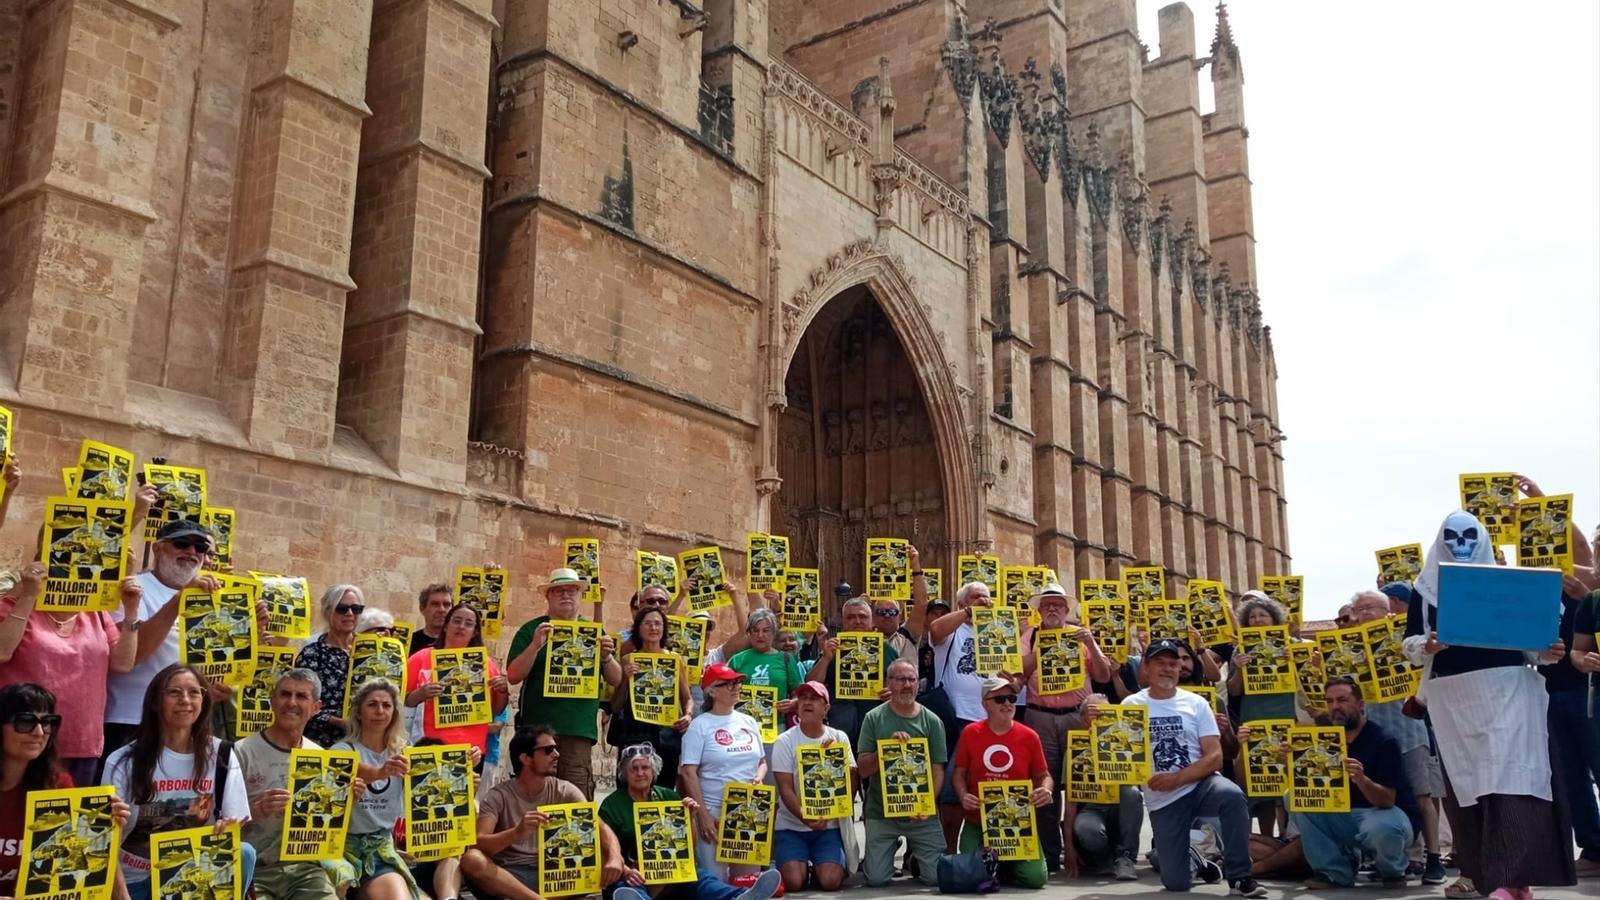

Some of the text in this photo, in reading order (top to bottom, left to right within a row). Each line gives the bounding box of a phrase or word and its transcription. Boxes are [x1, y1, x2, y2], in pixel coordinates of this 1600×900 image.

[1522, 557, 1553, 566] MALLORCA
[46, 581, 97, 593] MALLORCA
[44, 595, 56, 606] AL
[549, 677, 580, 685] MALLORCA
[1379, 674, 1413, 687] MALLORCA
[548, 685, 555, 693] AL
[439, 705, 472, 714] MALLORCA
[241, 712, 273, 722] MALLORCA
[440, 716, 447, 724] AL
[240, 723, 248, 732] AL
[1099, 763, 1131, 771] MALLORCA
[1251, 775, 1284, 784] MALLORCA
[152, 780, 213, 792] ARBORIDI
[1072, 783, 1102, 792] MALLORCA
[1252, 785, 1259, 793] AL
[1295, 789, 1330, 798] MALLORCA
[887, 795, 917, 803] MALLORCA
[1295, 799, 1302, 807] AL
[888, 805, 894, 813] AL
[412, 820, 453, 833] MALLORCA
[289, 830, 326, 842] MALLORCA
[412, 836, 421, 846] AL
[722, 840, 753, 850] MALLORCA
[988, 839, 1020, 847] MALLORCA
[286, 843, 295, 854] AL
[720, 850, 728, 858] AL
[544, 871, 581, 881] MALLORCA
[644, 872, 652, 880] AL
[544, 883, 552, 892] AL
